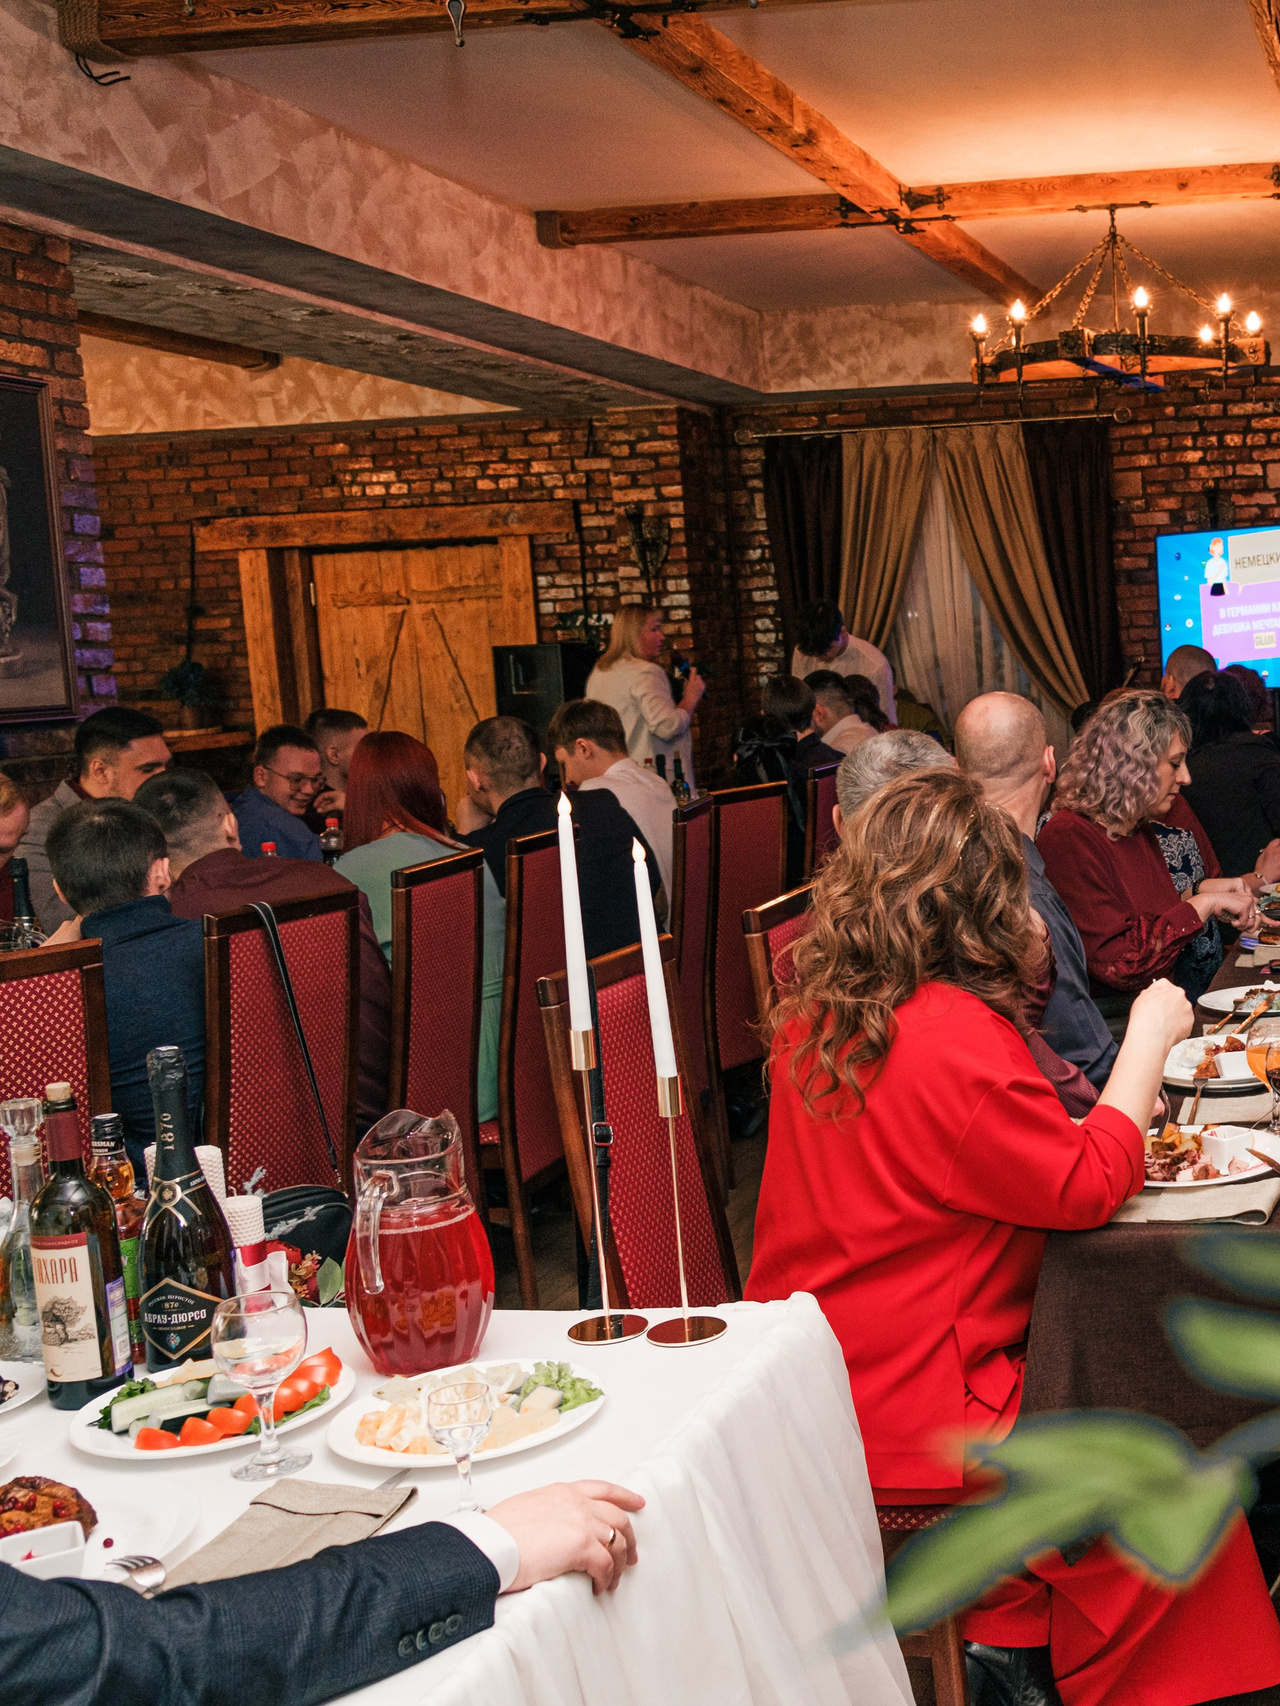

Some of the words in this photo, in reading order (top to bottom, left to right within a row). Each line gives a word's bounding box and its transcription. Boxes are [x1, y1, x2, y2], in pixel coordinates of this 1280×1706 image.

[1219, 607, 1226, 619] В
[1227, 603, 1271, 618] ГЕРМАНИИ
[1212, 621, 1251, 636] ДЕВУШКА
[160, 1112, 175, 1151] 1870
[144, 1309, 207, 1325] АБРАУ-ДЮРСО
